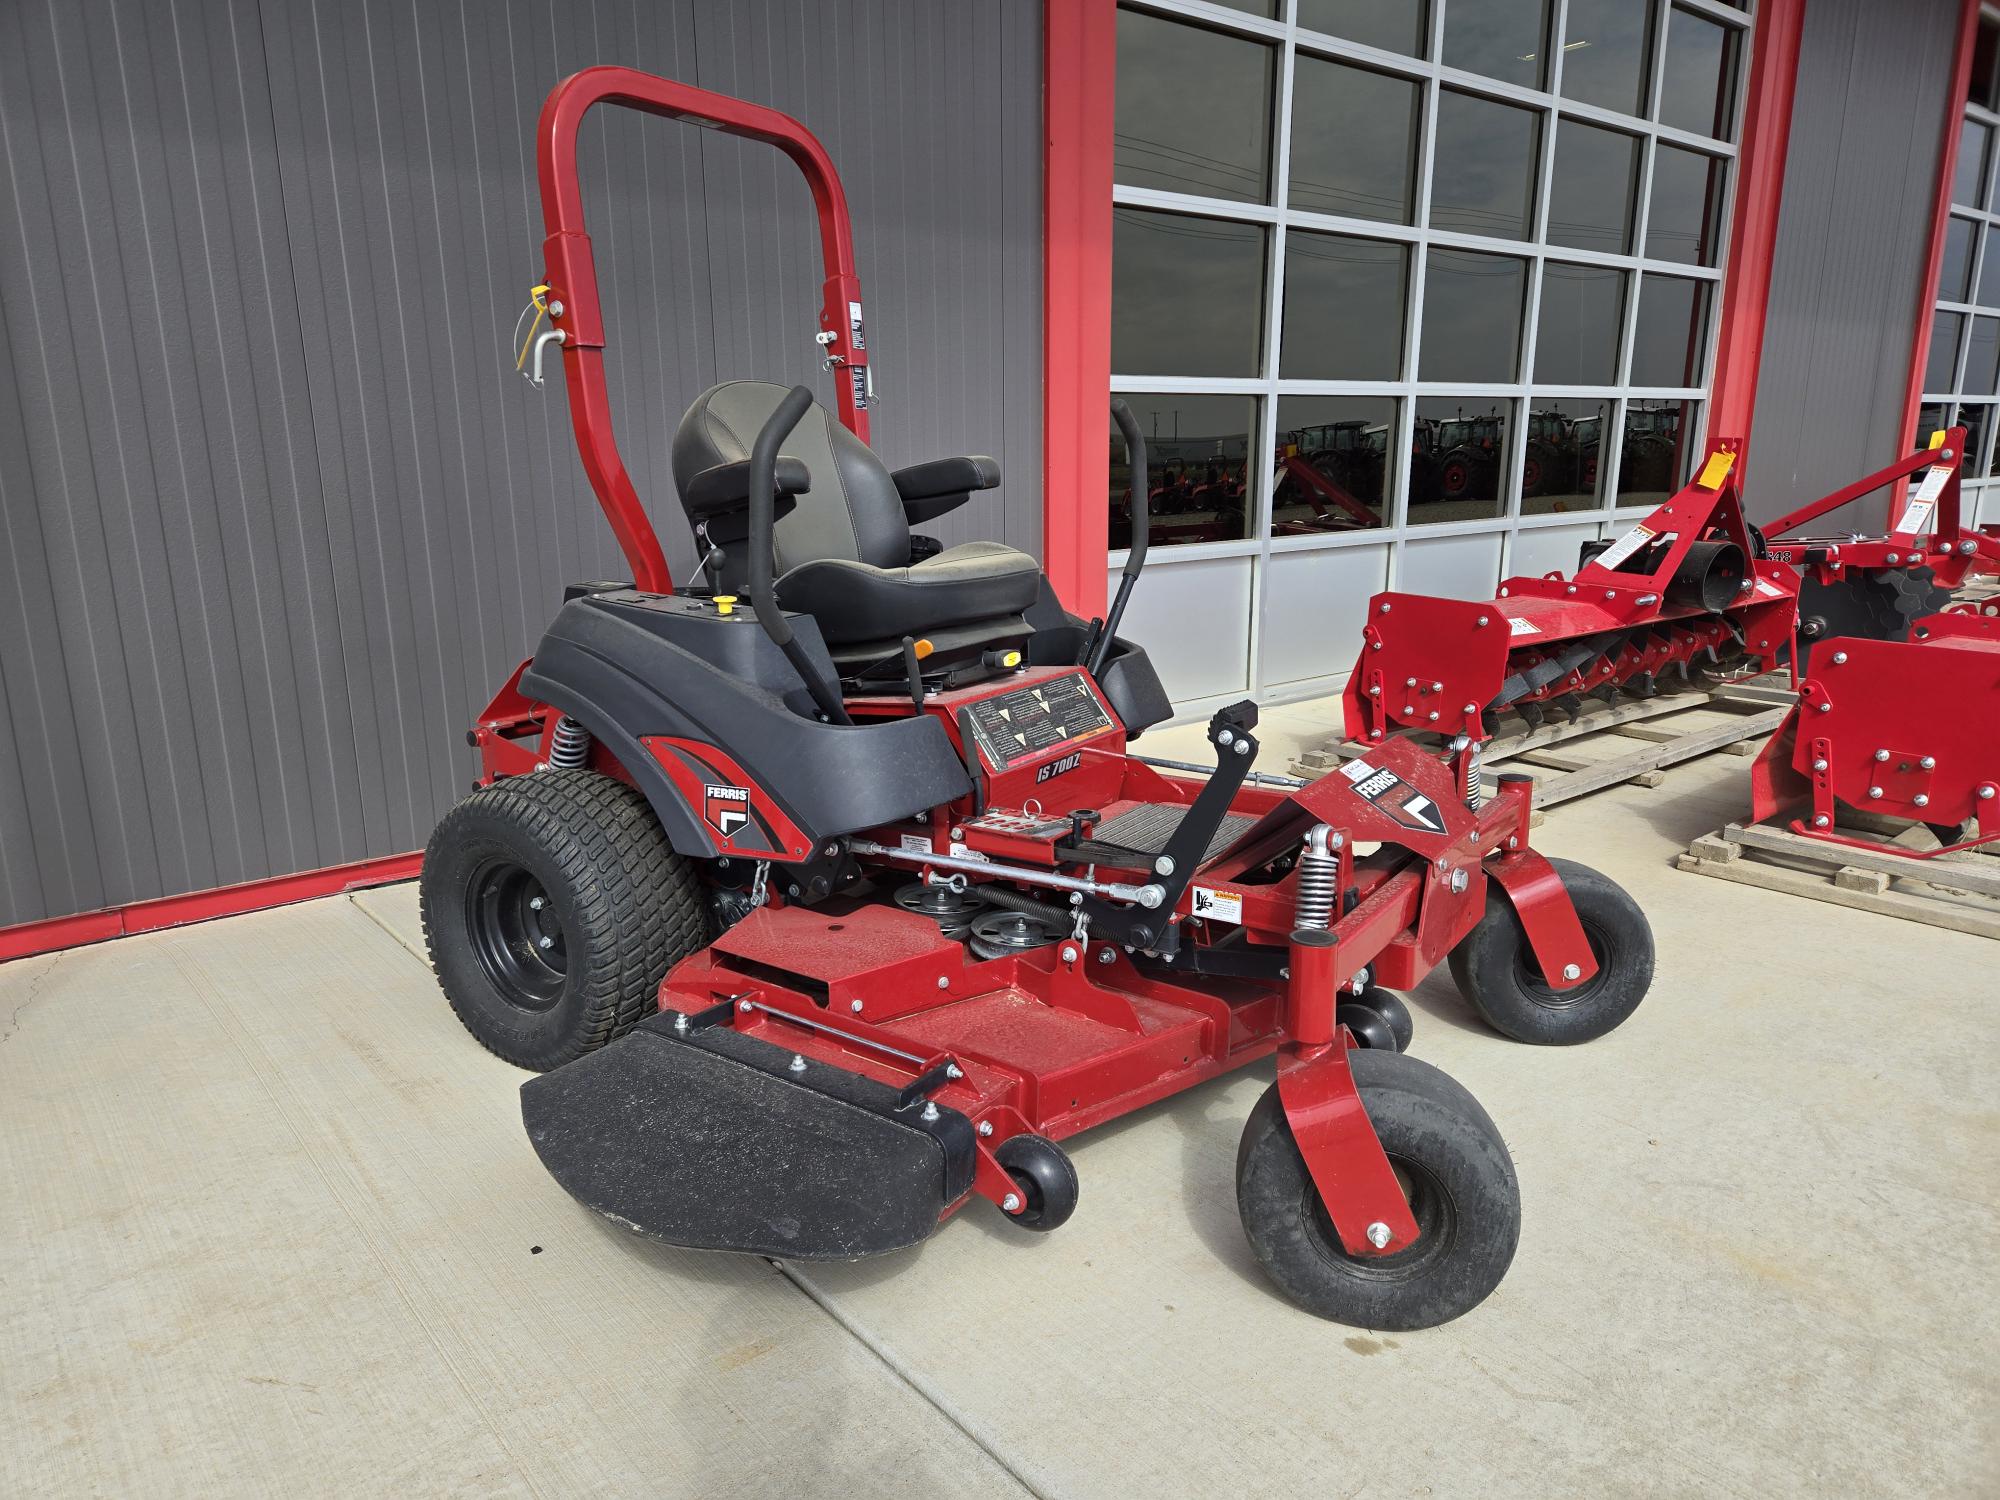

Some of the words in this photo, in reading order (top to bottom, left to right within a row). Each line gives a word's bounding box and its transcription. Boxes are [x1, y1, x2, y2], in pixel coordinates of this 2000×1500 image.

[1037, 765, 1050, 783] IS
[1052, 752, 1081, 776] 700Z
[707, 786, 747, 800] FERRIS
[1355, 770, 1398, 799] FERRIS
